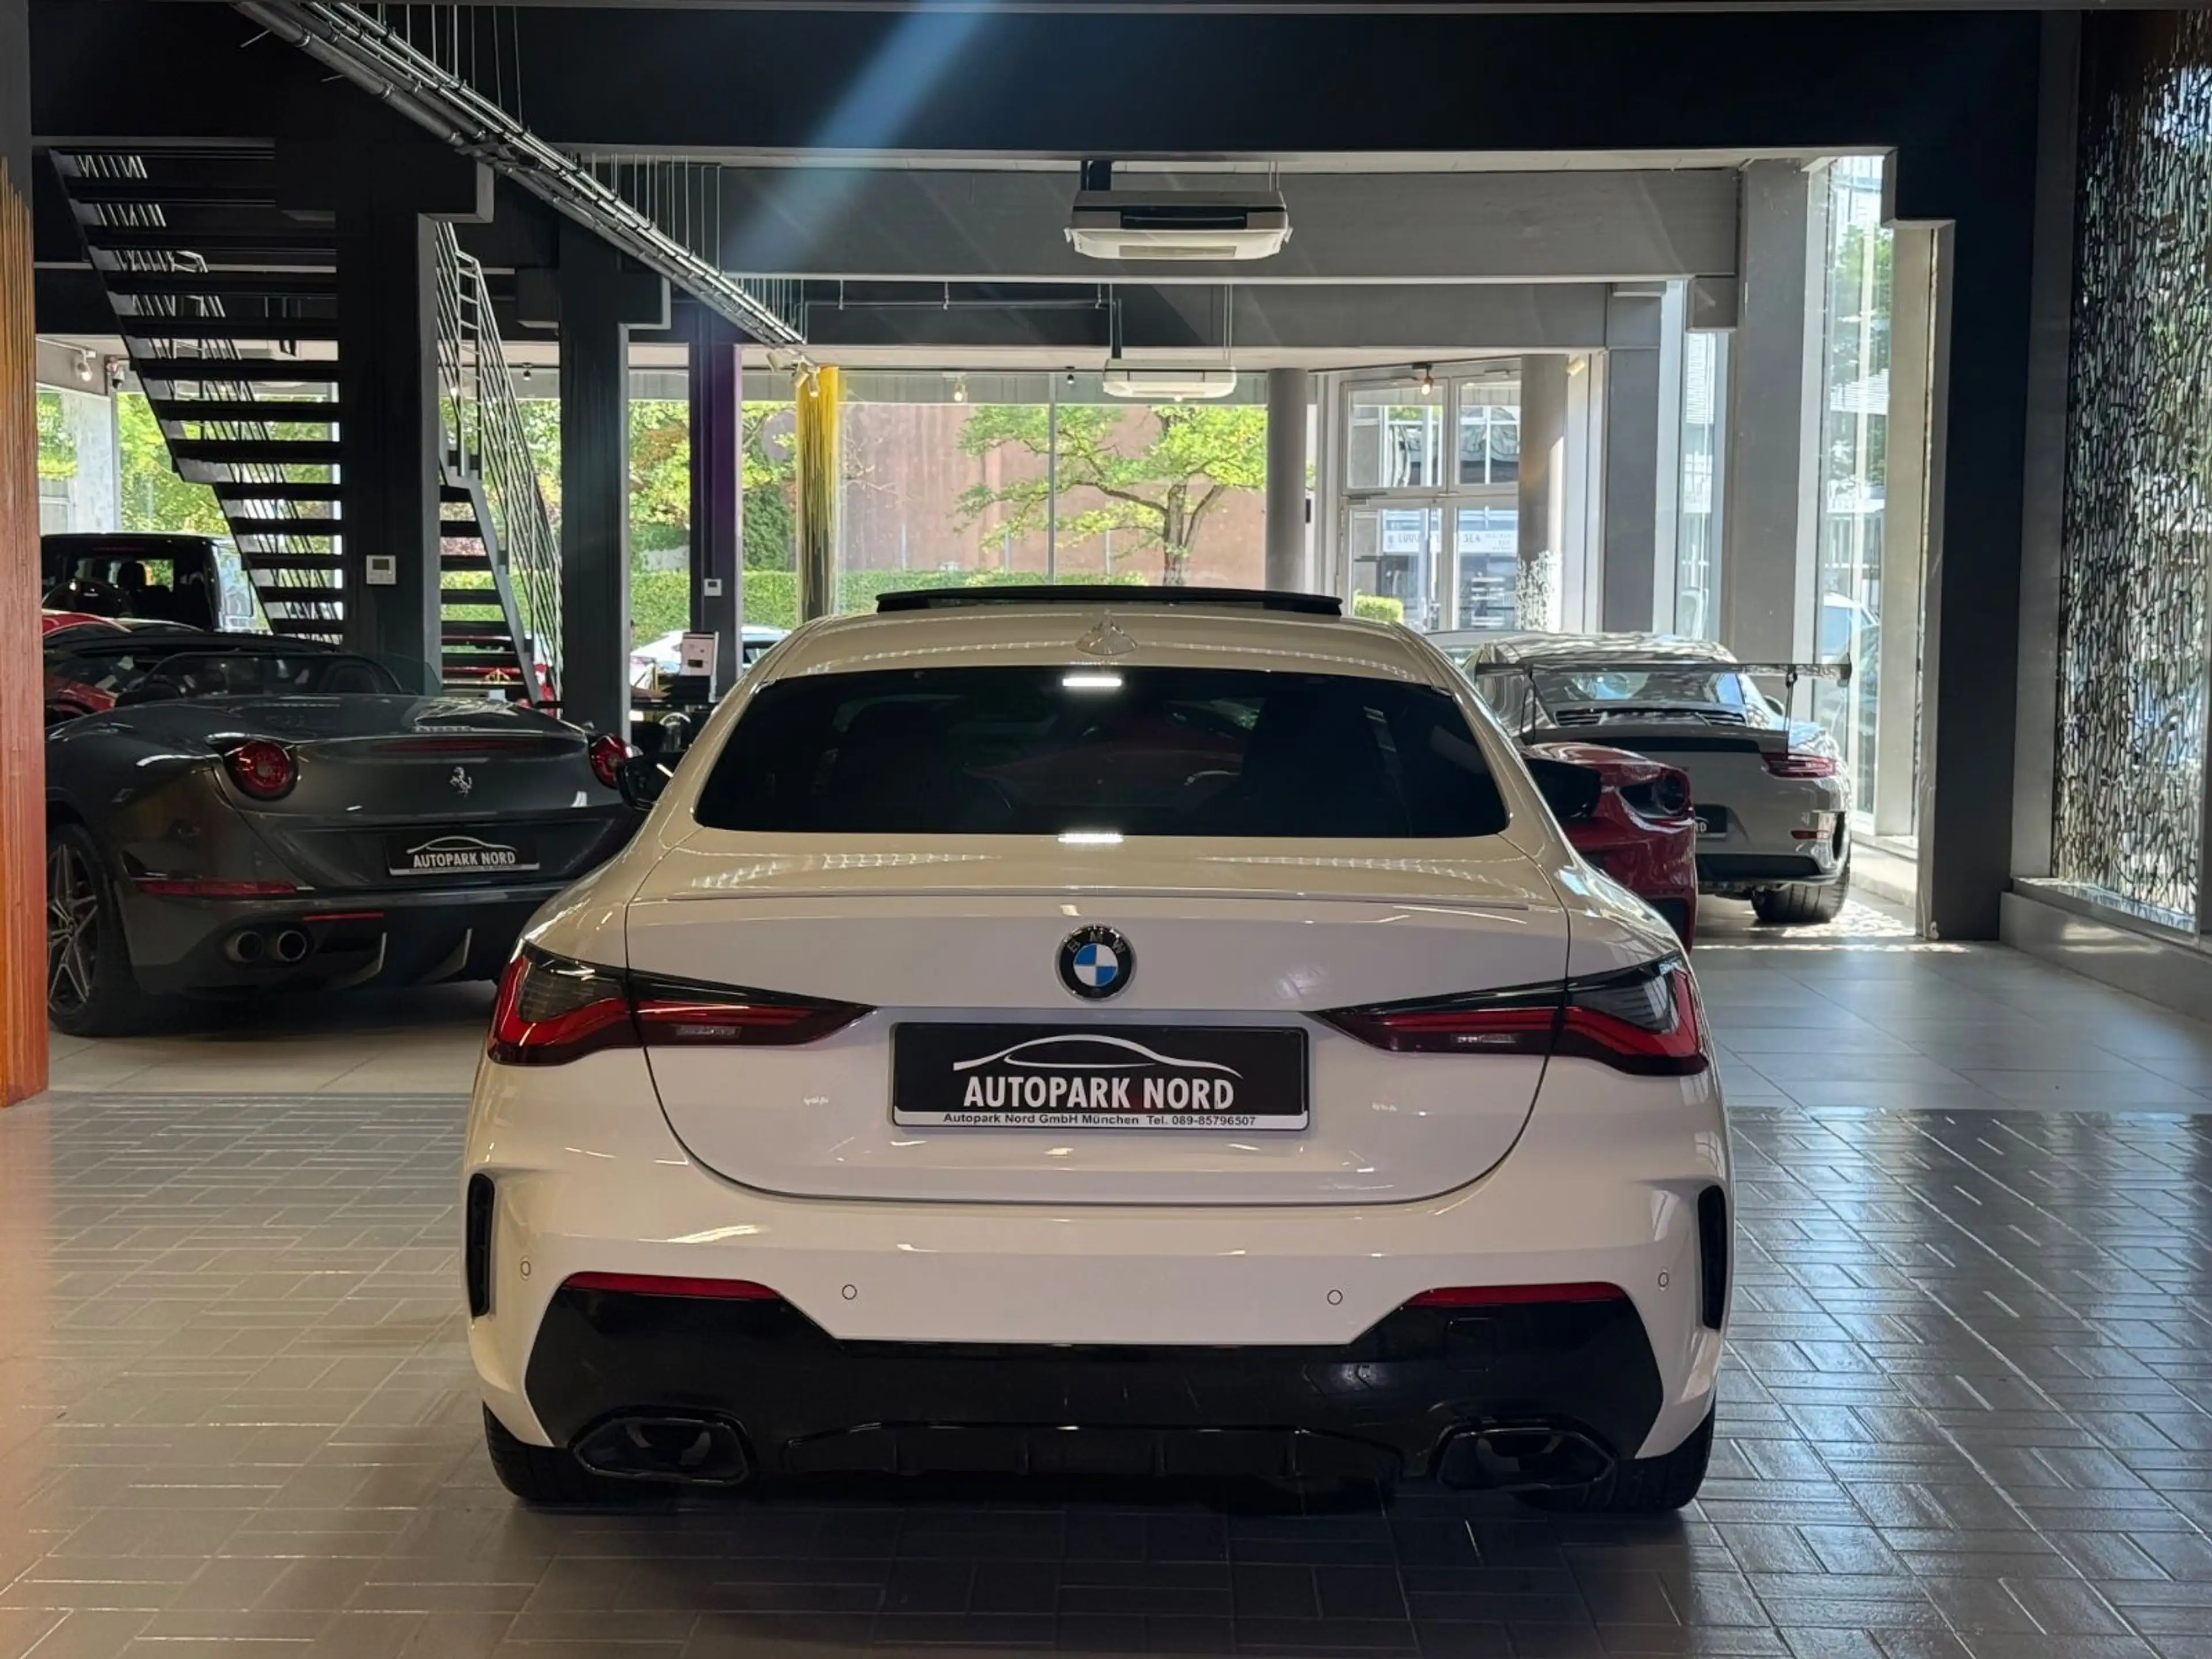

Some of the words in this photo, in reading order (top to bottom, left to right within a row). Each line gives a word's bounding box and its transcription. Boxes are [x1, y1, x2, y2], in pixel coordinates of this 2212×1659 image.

[414, 853, 478, 868] AUTOPARK
[481, 851, 516, 865] NORD
[1067, 930, 1126, 954] BMW
[963, 1076, 1131, 1109] AUTOPARK
[1143, 1077, 1234, 1110] NORD
[943, 1113, 1001, 1124] Autopark
[1005, 1113, 1035, 1123] Nord
[1039, 1114, 1078, 1124] GmbH
[1082, 1113, 1139, 1124] München
[1146, 1115, 1168, 1124] Tel.
[1172, 1116, 1256, 1126] 089-85796507
